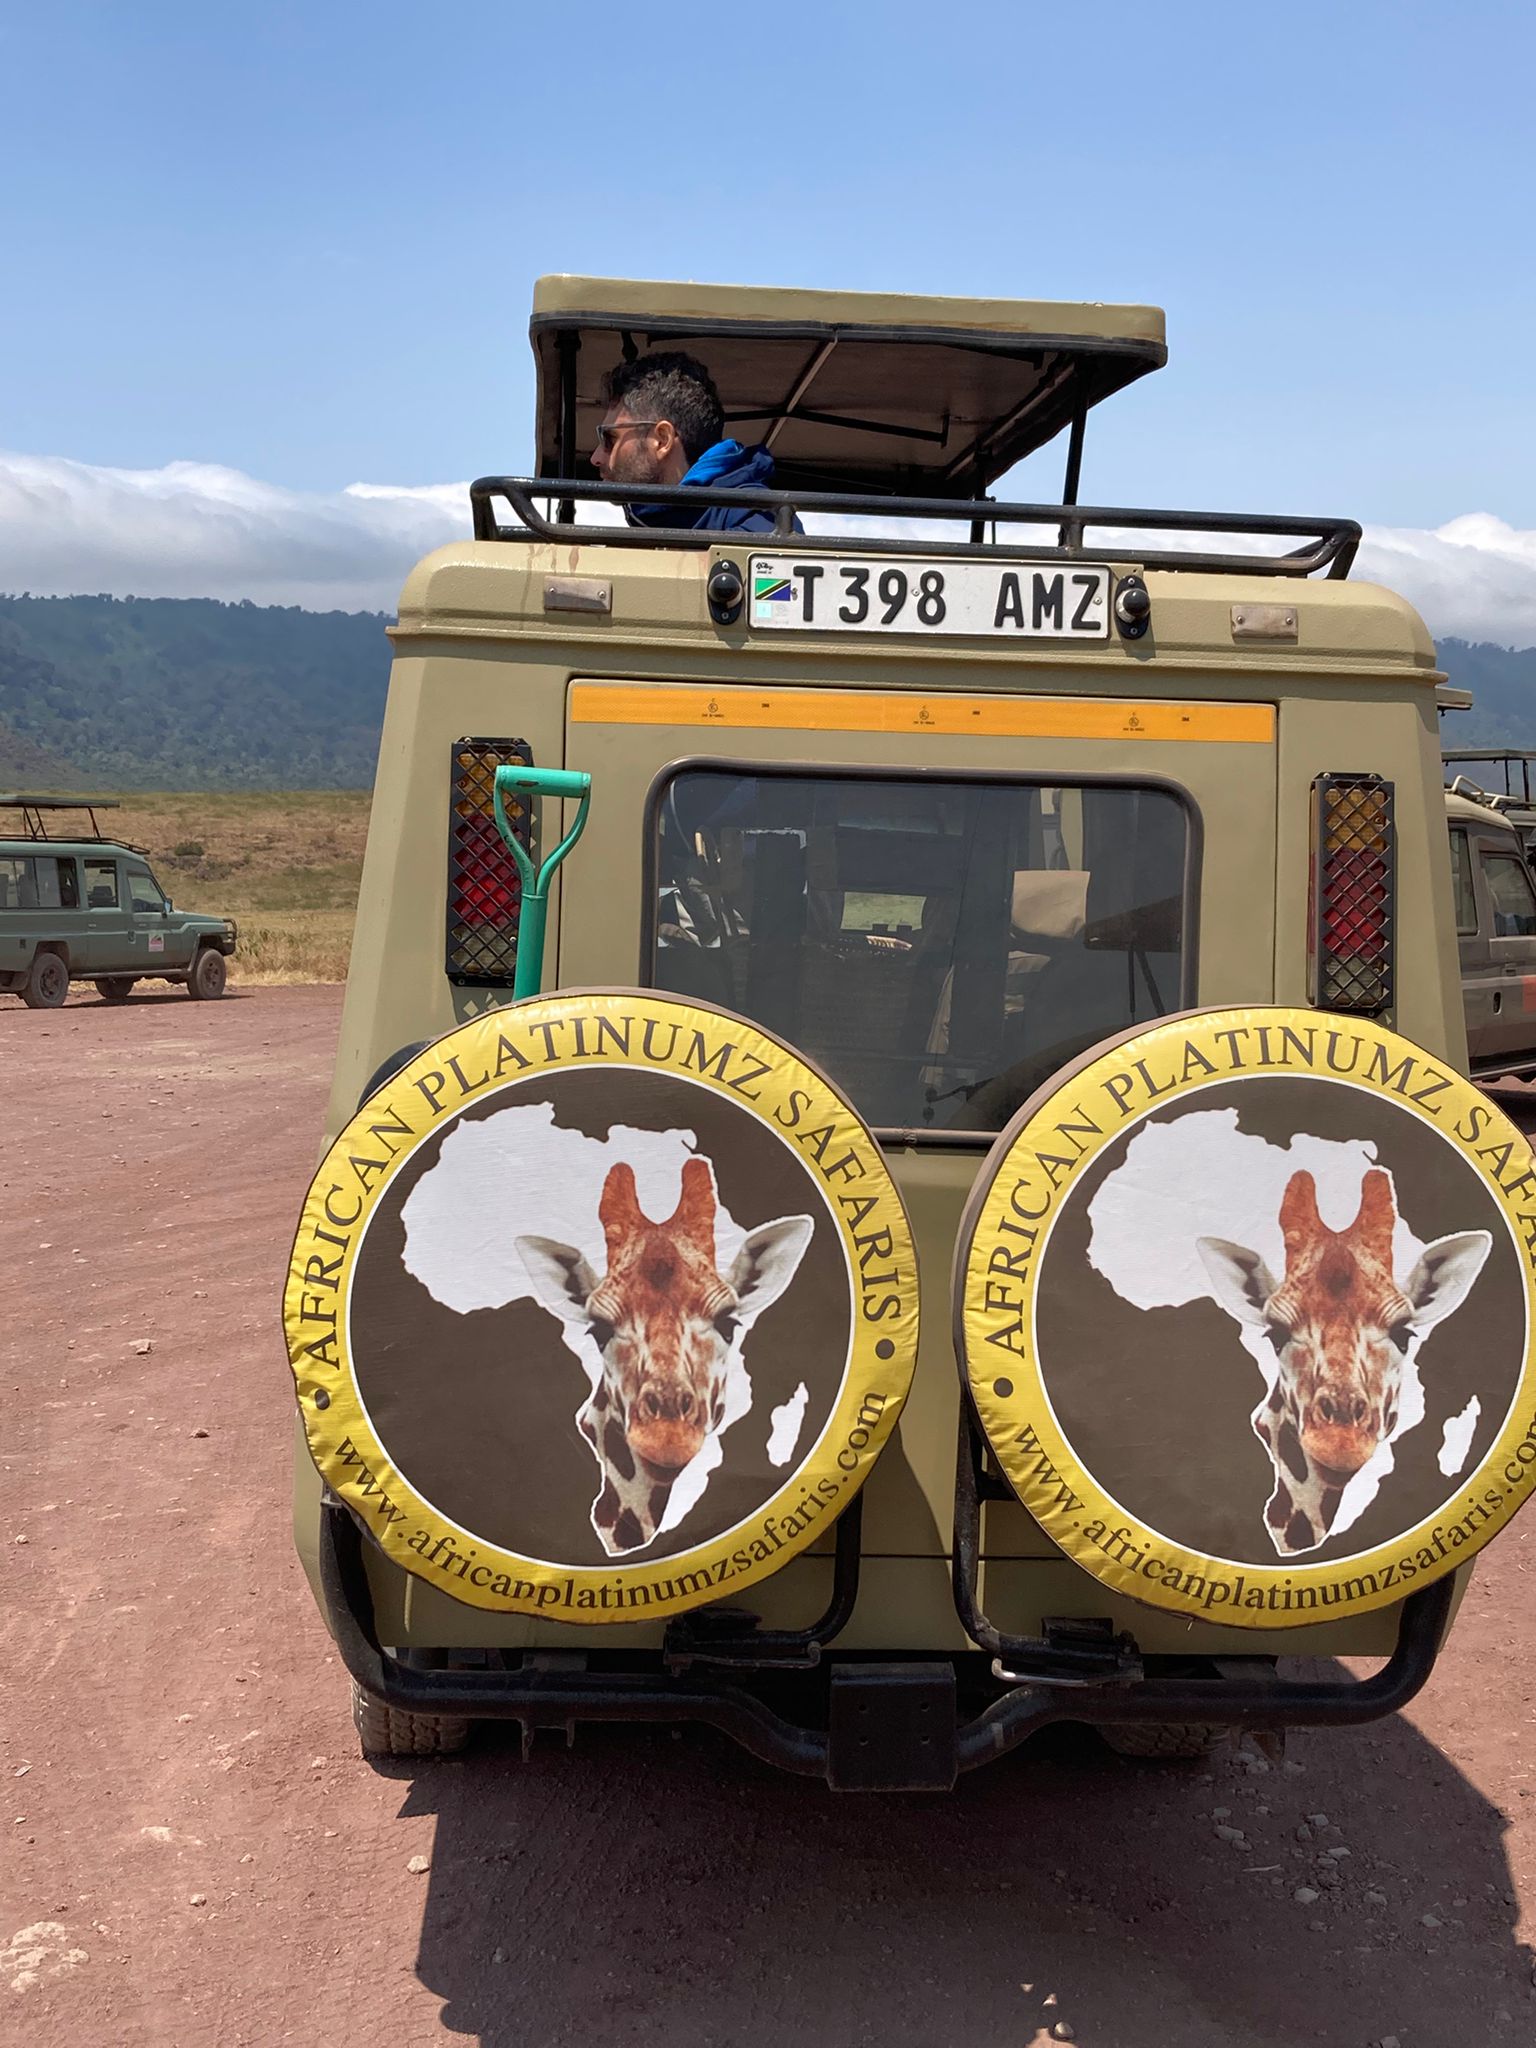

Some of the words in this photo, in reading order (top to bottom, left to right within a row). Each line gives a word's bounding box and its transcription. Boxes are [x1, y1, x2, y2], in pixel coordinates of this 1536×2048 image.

[994, 572, 1102, 631] AMZ
[301, 1105, 413, 1370] AFRICAN
[413, 1016, 775, 1116] PLATINUMZ
[772, 1090, 903, 1323] SAFARIS
[984, 1105, 1104, 1359] AFRICAN
[1101, 1026, 1453, 1115] PLATINUMZ
[335, 1393, 888, 1610] www.africanplatinumzsafaris.com
